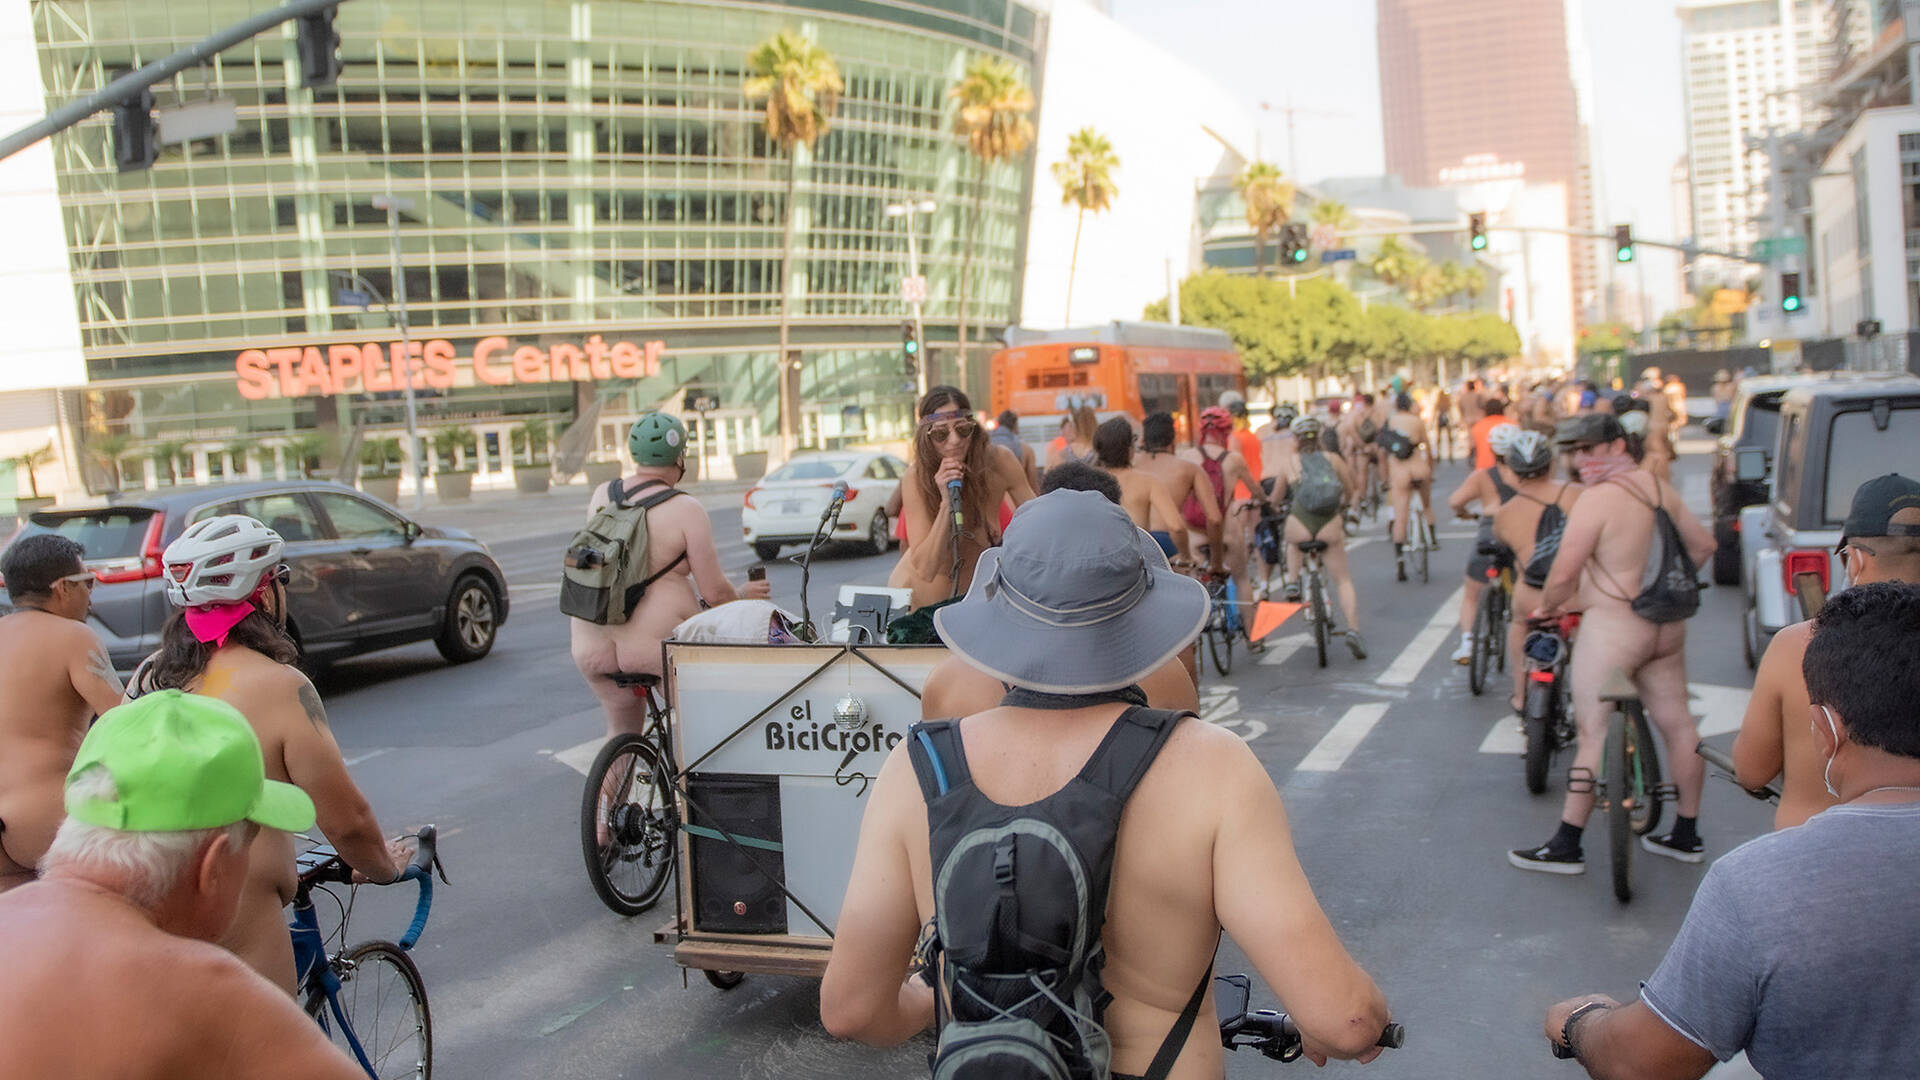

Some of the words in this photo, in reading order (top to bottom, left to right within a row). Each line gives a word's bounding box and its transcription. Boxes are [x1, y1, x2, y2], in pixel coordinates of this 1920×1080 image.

[235, 339, 456, 399] STAPLES
[473, 334, 665, 385] Center
[790, 700, 811, 720] el
